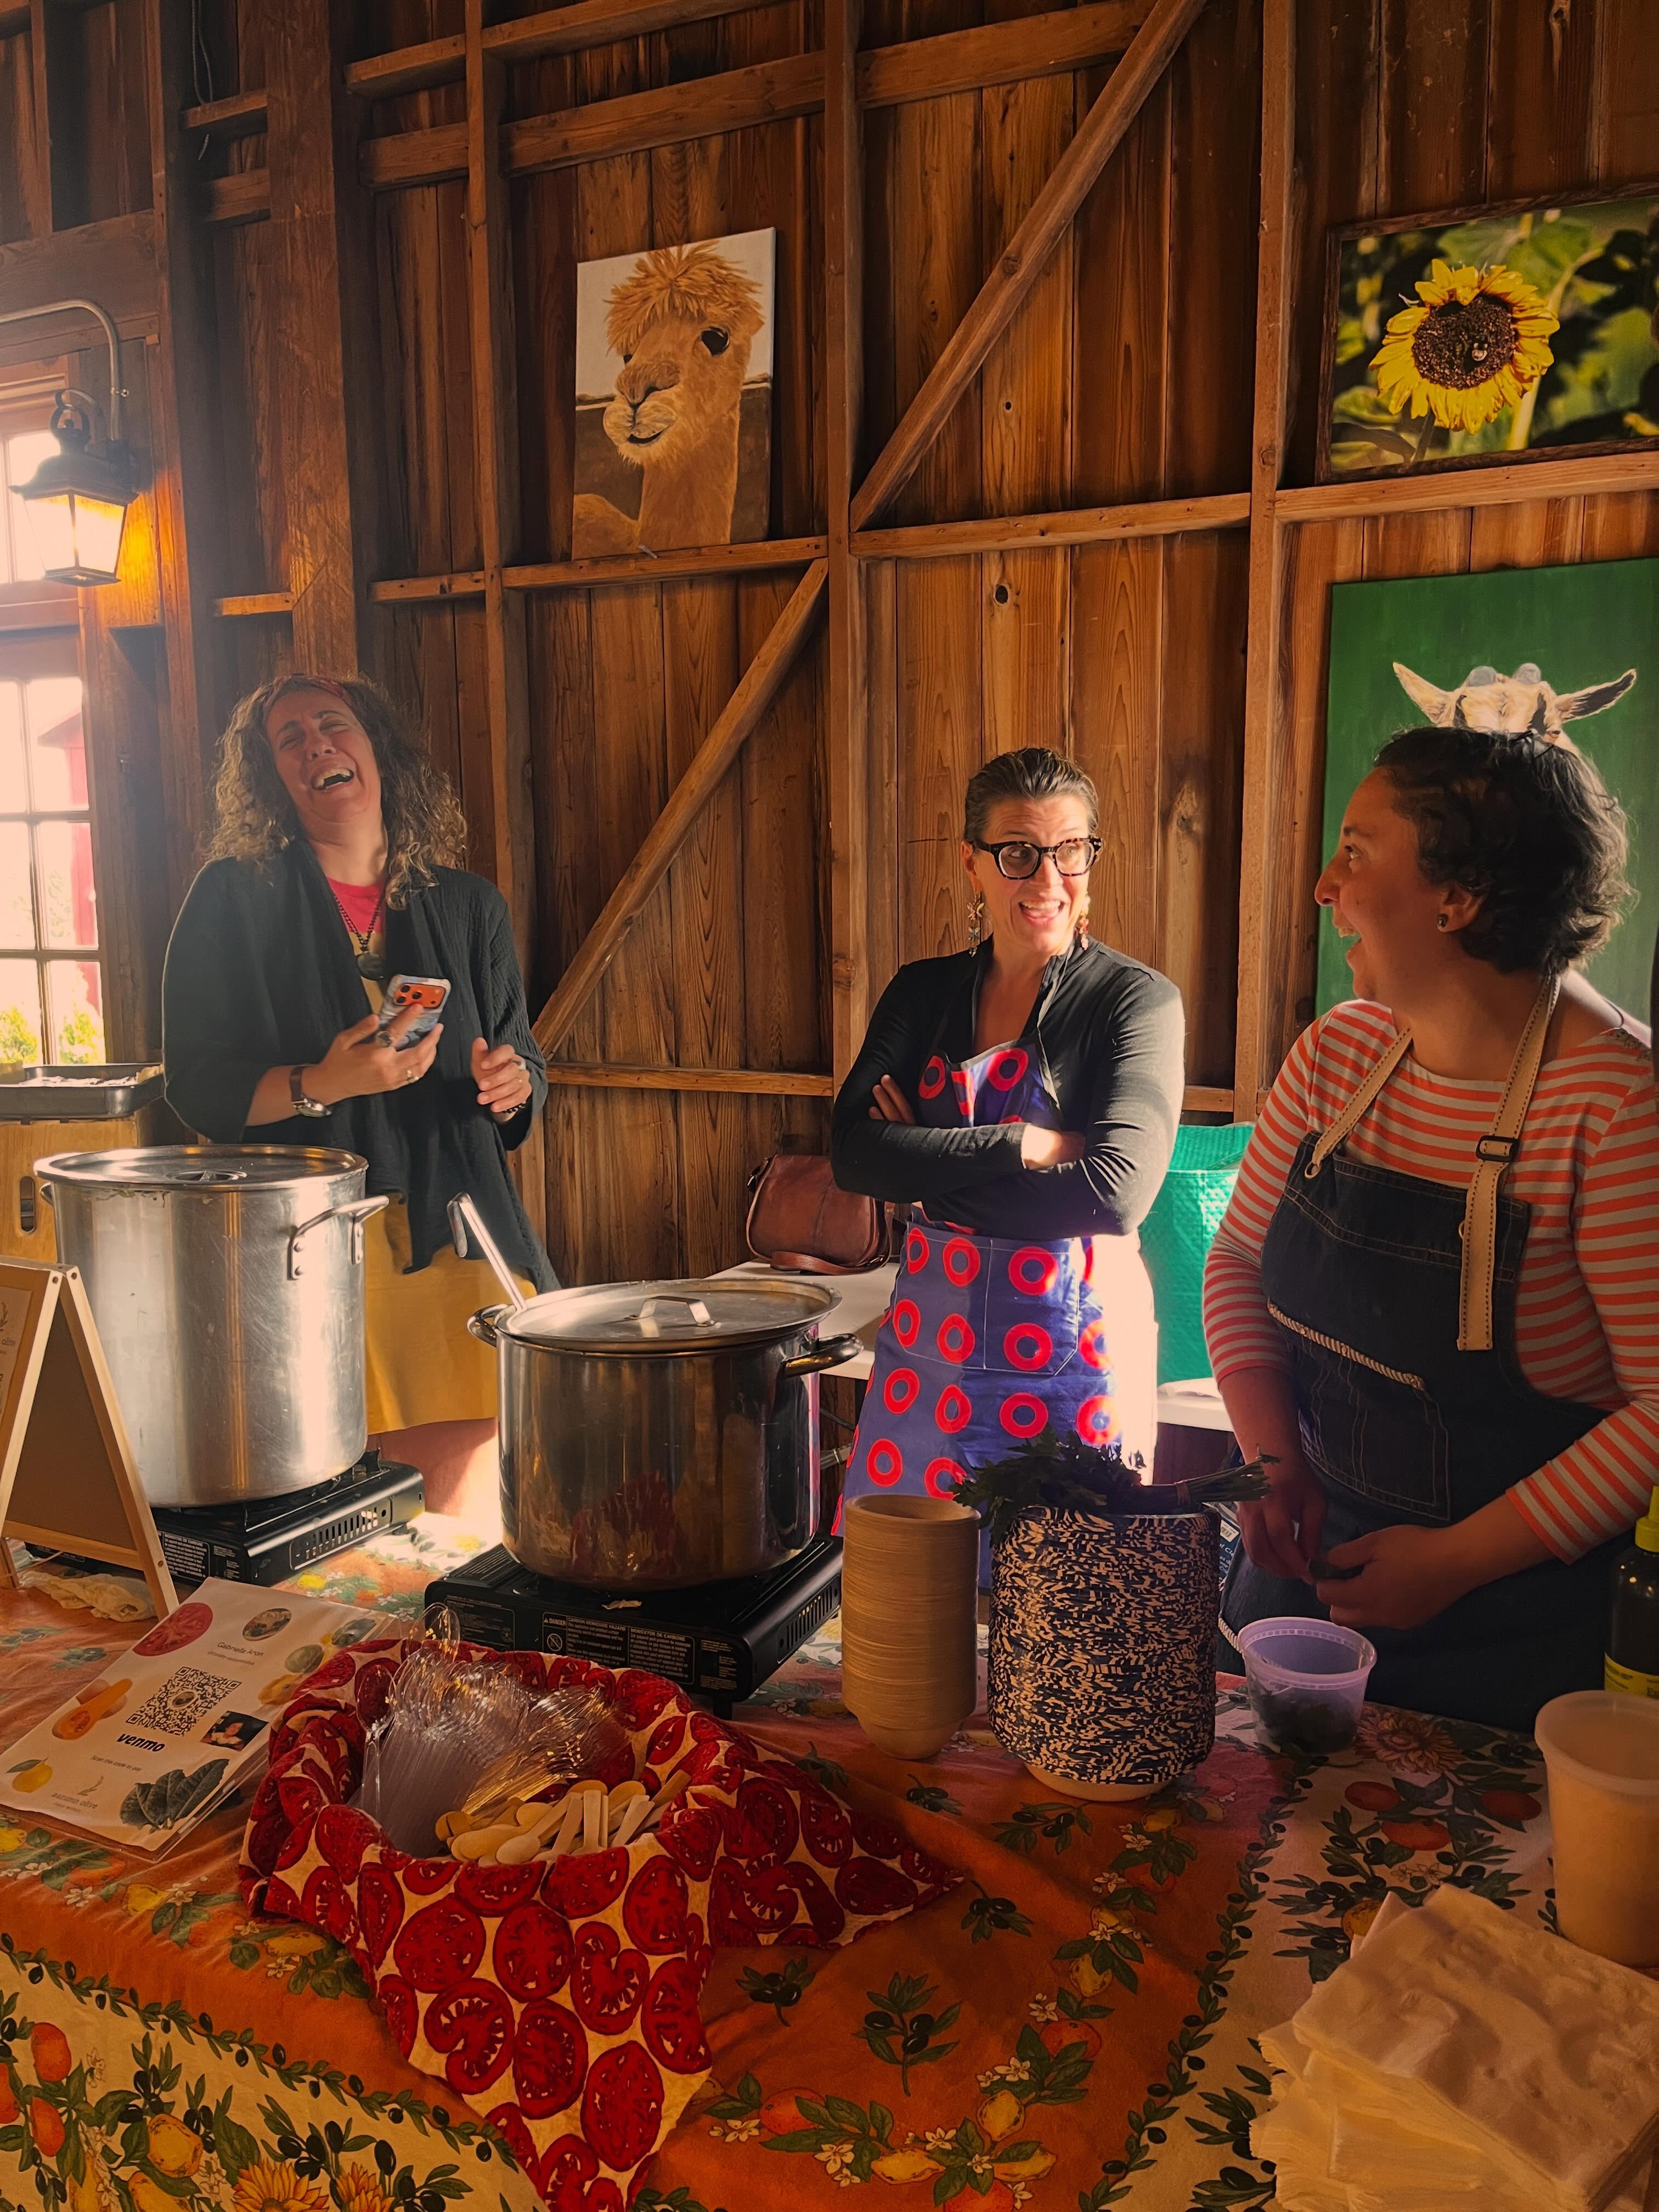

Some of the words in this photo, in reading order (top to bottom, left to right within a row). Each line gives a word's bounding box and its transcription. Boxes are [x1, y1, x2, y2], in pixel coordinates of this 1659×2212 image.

[217, 1641, 246, 1654] Gabriella
[116, 1733, 166, 1752] venmo
[91, 1755, 104, 1763] Scan
[52, 1793, 80, 1804] autumn
[80, 1799, 98, 1809] olive
